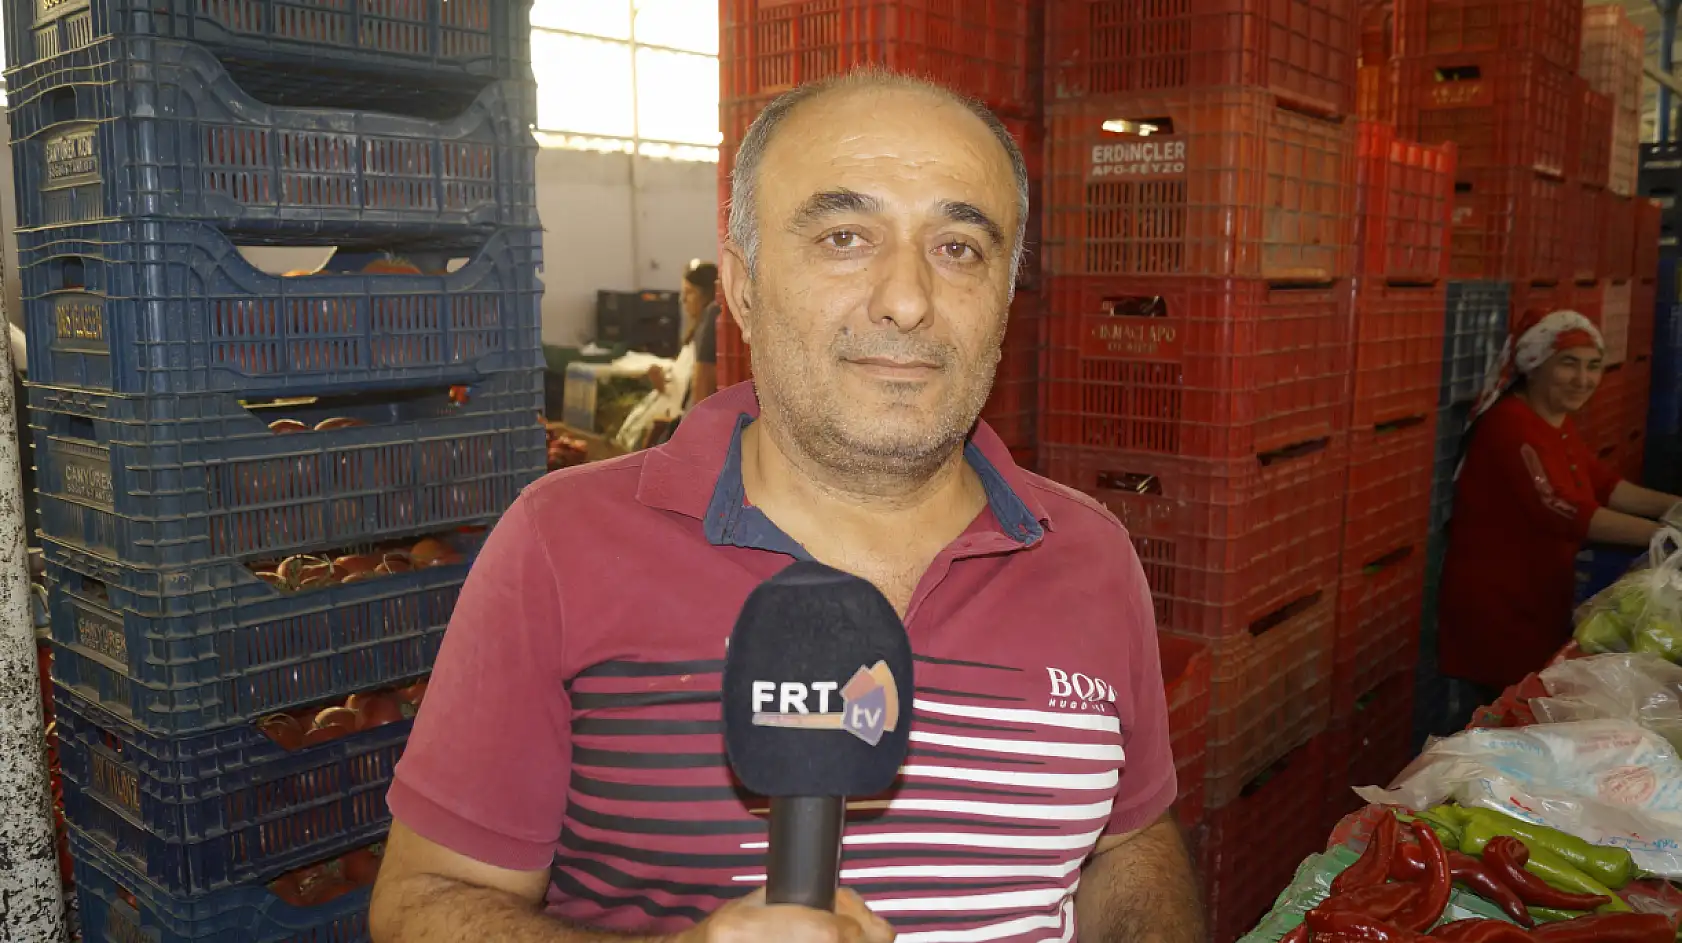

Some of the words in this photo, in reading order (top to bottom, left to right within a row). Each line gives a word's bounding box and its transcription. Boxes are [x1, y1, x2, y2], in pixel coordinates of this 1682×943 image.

[751, 680, 839, 715] FRT
[850, 703, 883, 730] tv
[1048, 697, 1088, 711] HUGO
